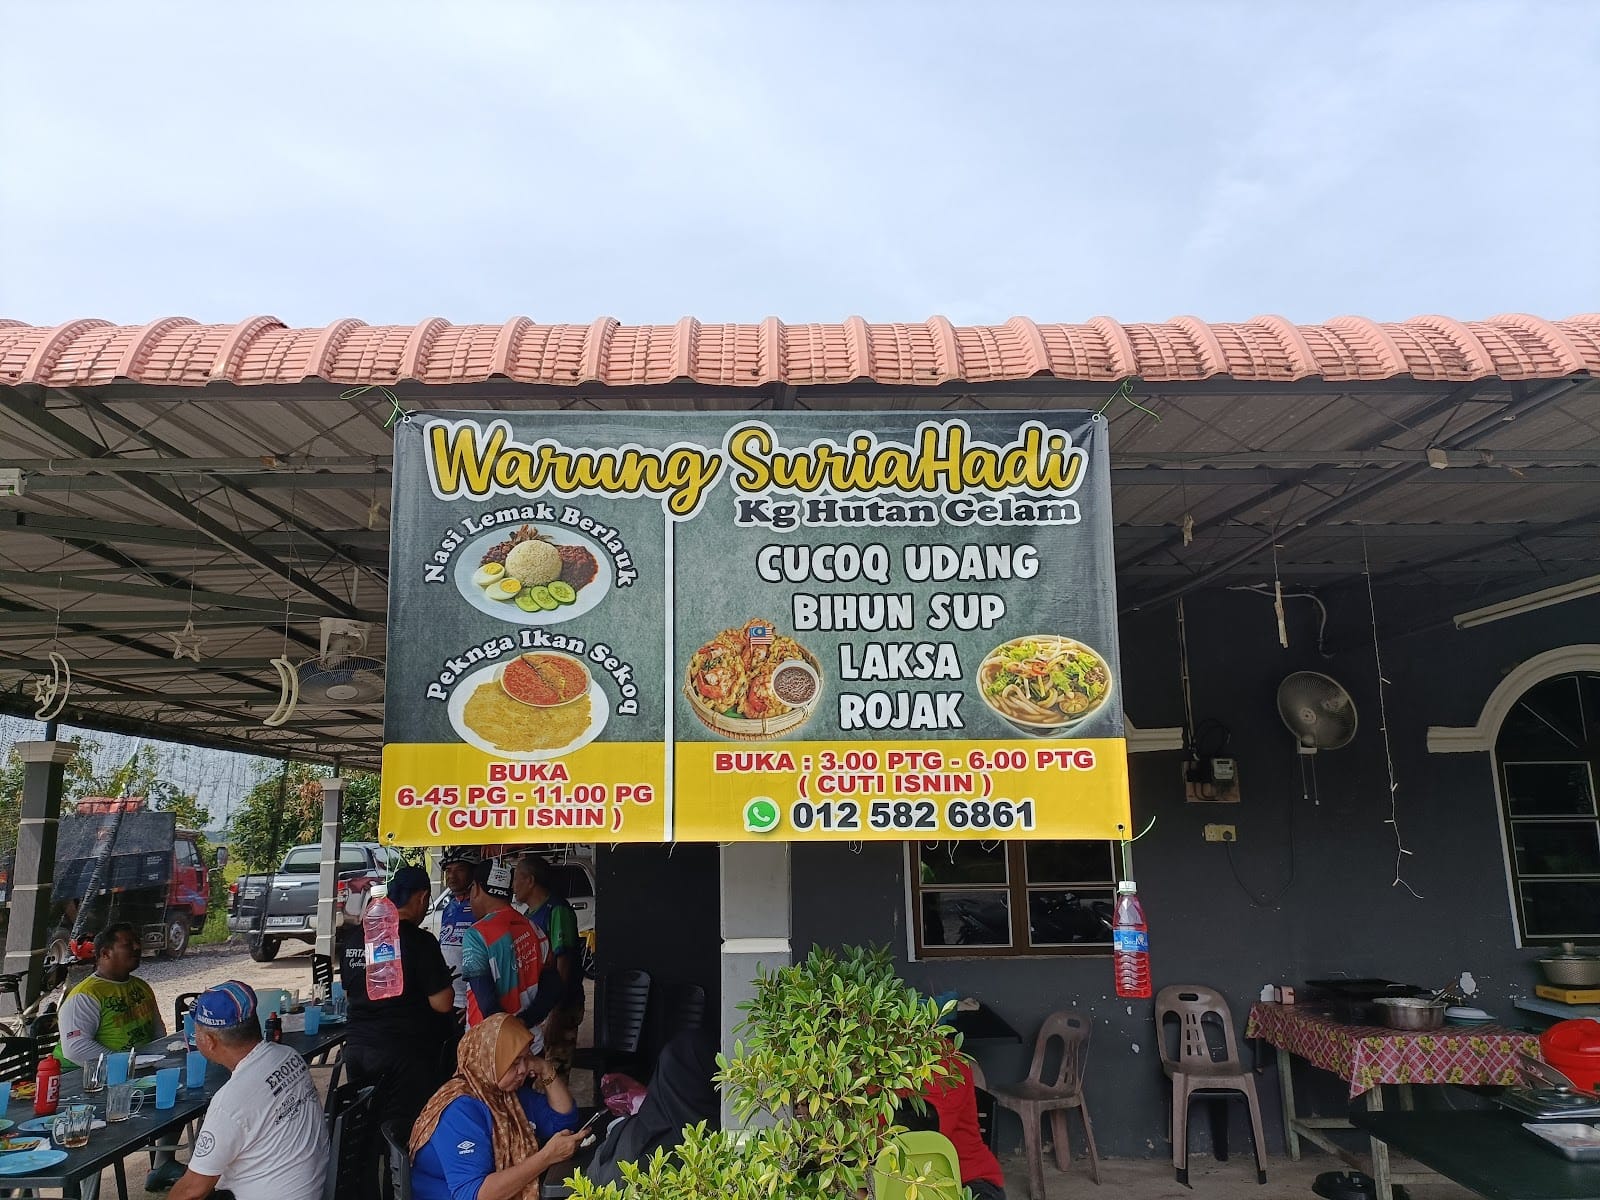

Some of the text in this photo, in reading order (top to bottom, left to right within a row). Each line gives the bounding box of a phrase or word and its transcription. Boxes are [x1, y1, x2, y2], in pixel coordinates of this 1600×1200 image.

[428, 422, 1084, 518] Warung SuriaHadi
[737, 498, 1079, 528] Kg Hutan Gelam
[425, 503, 638, 587] Nasi Lemak Berlauk
[757, 543, 1040, 583] CUCOQ UDANG
[793, 592, 1006, 631] BIHUN SUP
[426, 634, 515, 701] Peknga
[520, 629, 585, 654] Ikan
[839, 642, 962, 681] LAKSA
[839, 691, 964, 731] ROJAK
[489, 763, 569, 783] BUKA
[715, 752, 795, 771] BUKA
[820, 751, 878, 771] 3.00
[889, 751, 943, 770] PTG
[968, 750, 1028, 770] 6.00
[1037, 750, 1094, 769] PTG
[397, 787, 459, 807] 6.45
[467, 786, 507, 805] PG
[533, 785, 607, 805] 11.00
[615, 784, 653, 803] PG
[792, 801, 1033, 829] 012 582 6861
